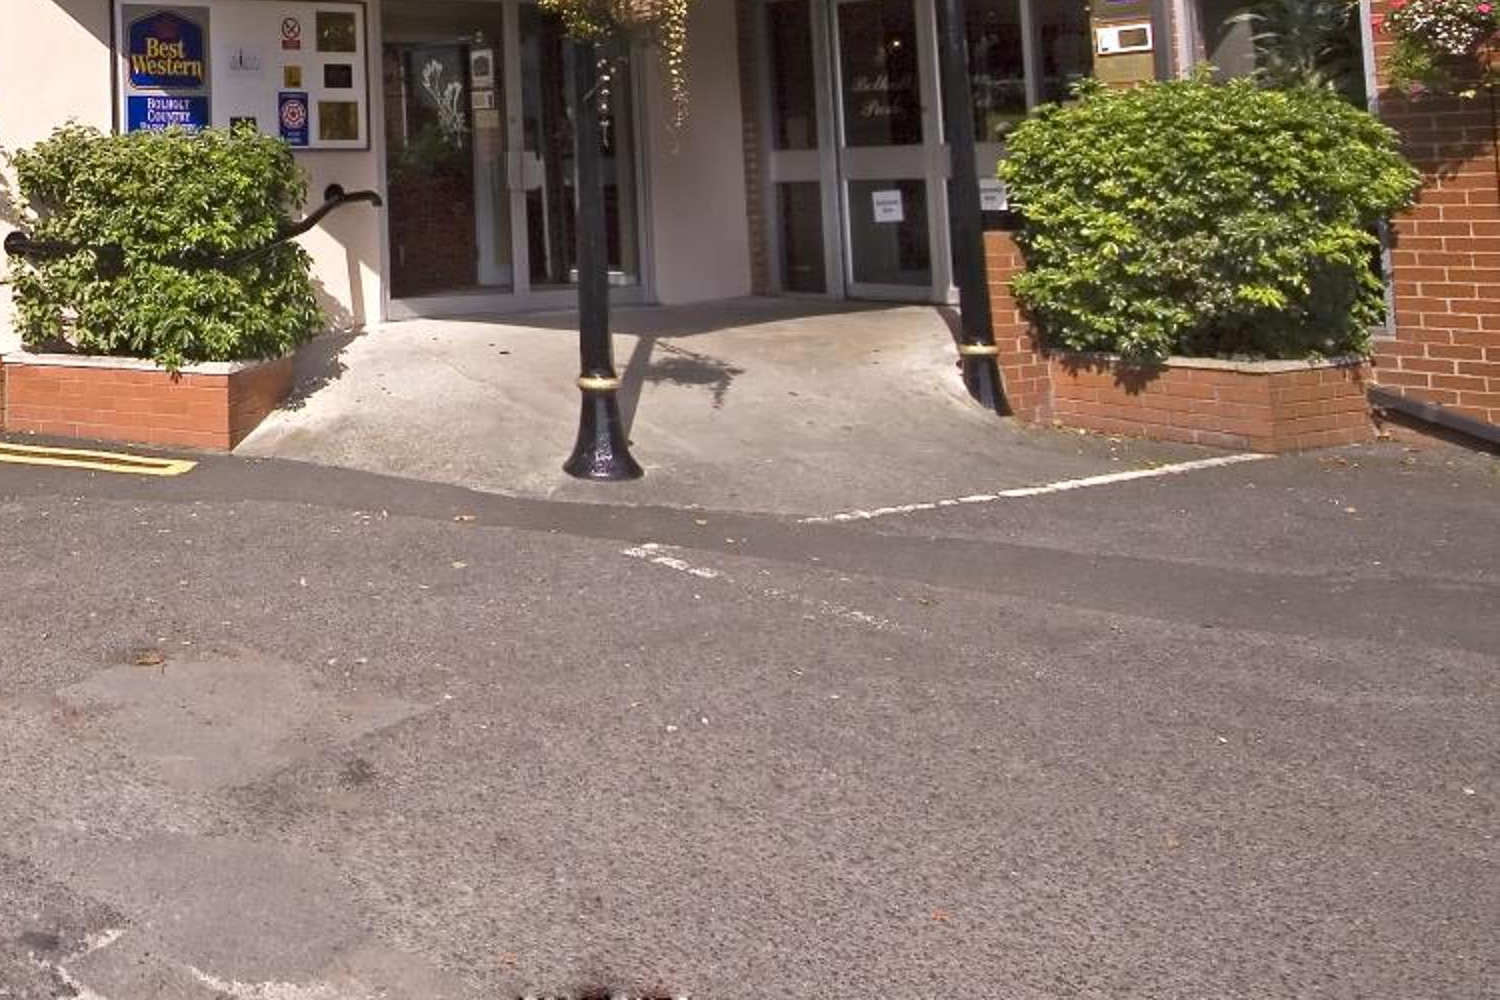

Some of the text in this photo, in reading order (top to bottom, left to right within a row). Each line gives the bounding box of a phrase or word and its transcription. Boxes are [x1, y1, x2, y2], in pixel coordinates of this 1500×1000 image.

[146, 37, 186, 59] Best
[131, 55, 204, 81] Western
[147, 109, 191, 123] COUNTRY
